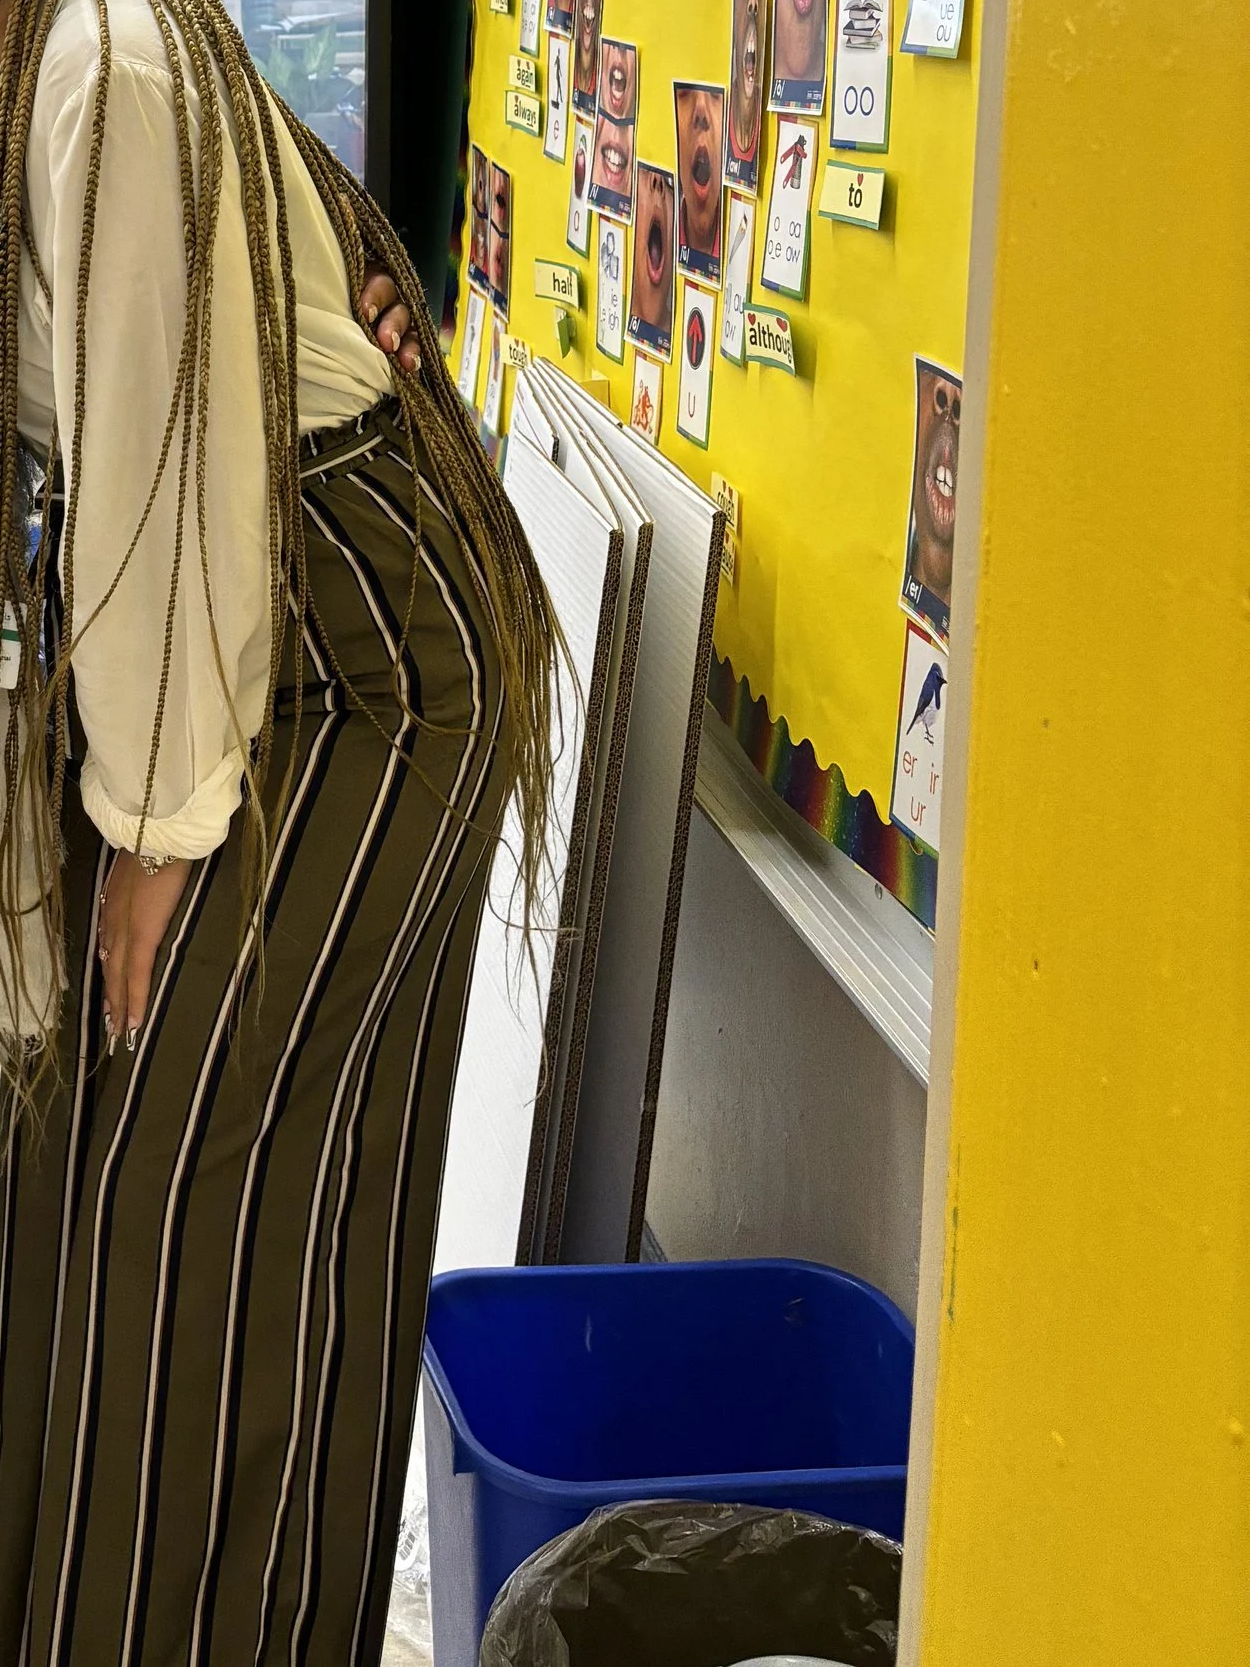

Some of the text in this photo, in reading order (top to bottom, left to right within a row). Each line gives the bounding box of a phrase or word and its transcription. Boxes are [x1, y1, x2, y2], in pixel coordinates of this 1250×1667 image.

[940, 3, 954, 20] ue
[936, 24, 952, 42] ou
[516, 66, 533, 85] again
[843, 85, 875, 116] oo
[513, 101, 537, 126] always
[553, 119, 560, 140] e
[848, 183, 863, 209] to
[552, 272, 573, 297] half
[687, 391, 697, 418] u
[902, 750, 940, 795] er ir
[910, 796, 927, 826] ur
